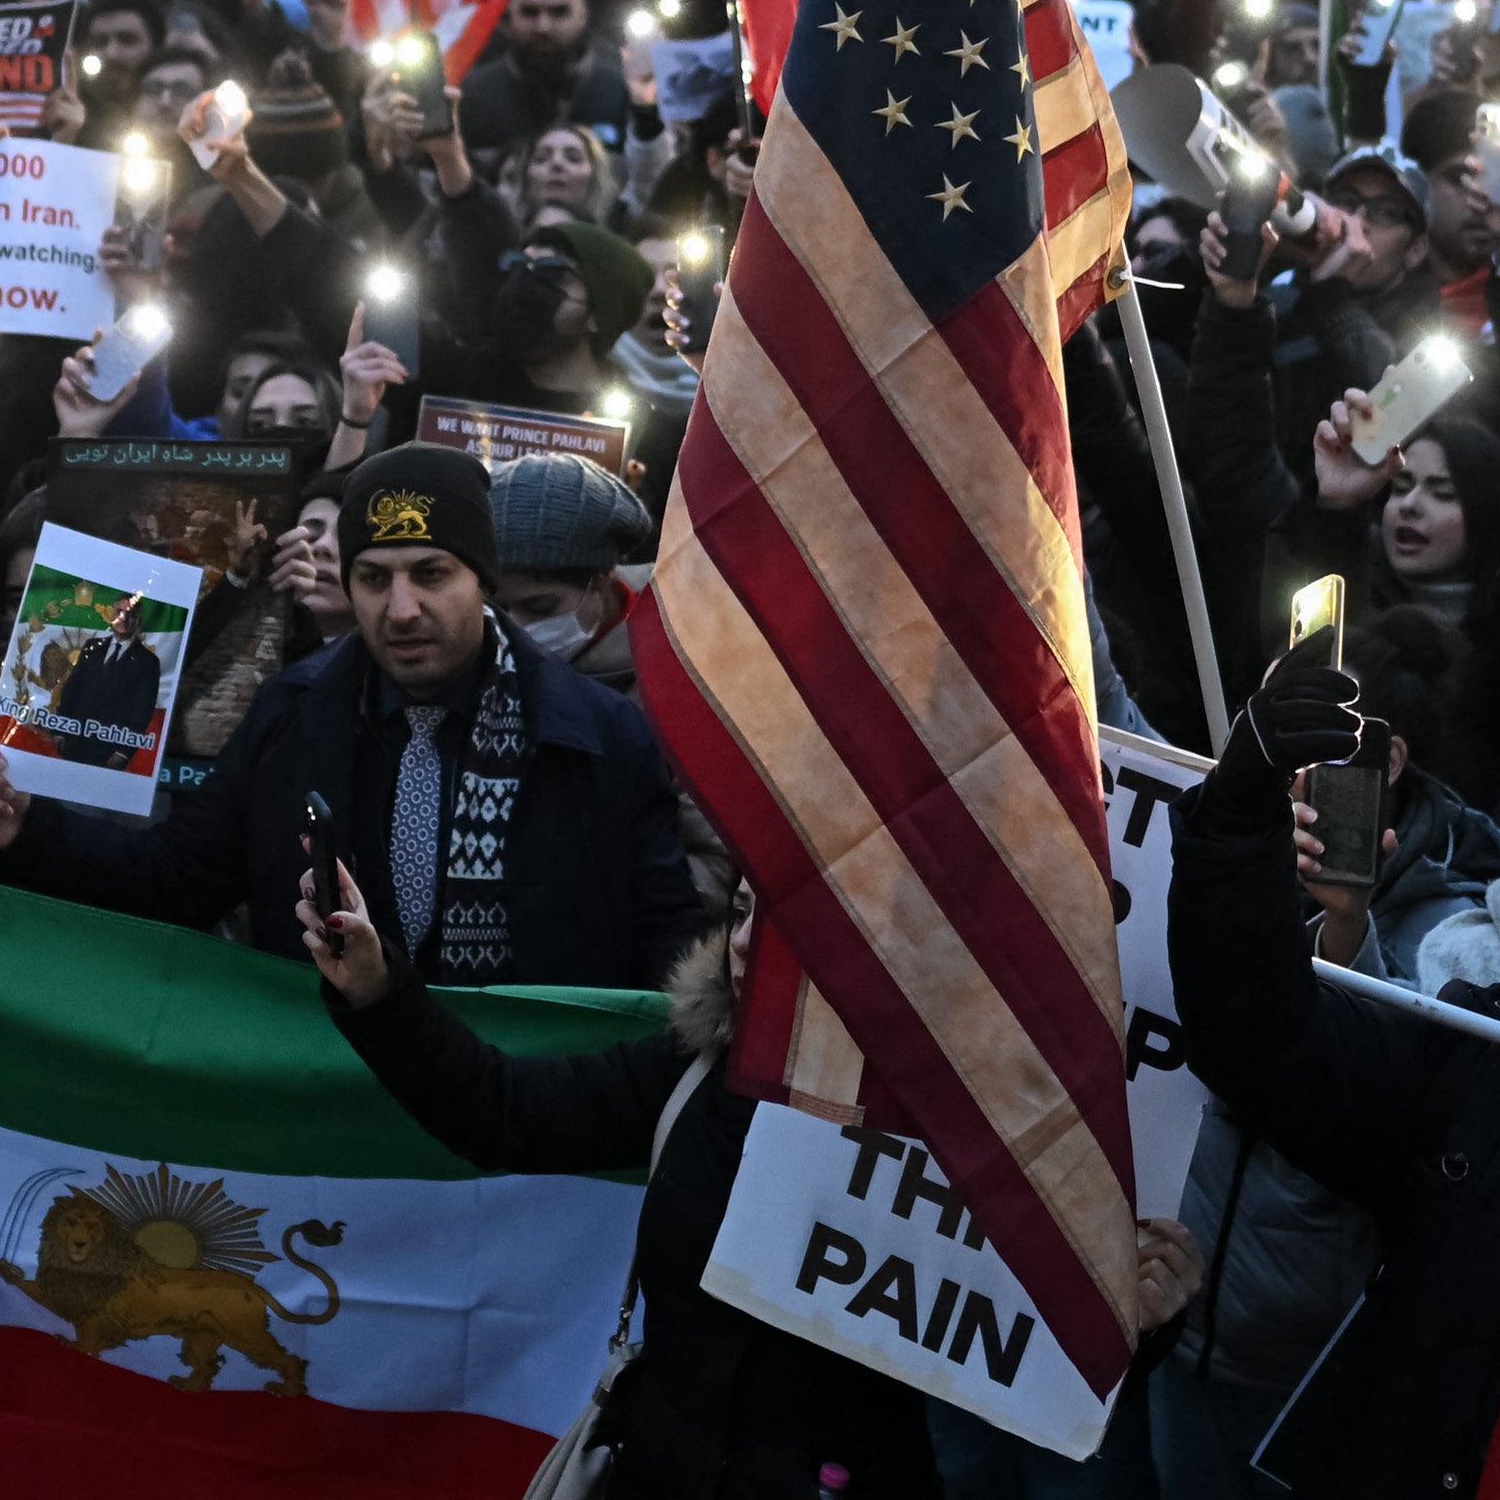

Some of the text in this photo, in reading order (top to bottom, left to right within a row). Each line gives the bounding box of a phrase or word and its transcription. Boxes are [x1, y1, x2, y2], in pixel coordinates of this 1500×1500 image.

[1081, 16, 1118, 32] NT
[21, 199, 82, 229] Iran.
[437, 416, 607, 453] WE WANT PRINCE PAHLAVI
[113, 443, 157, 464] ایران
[201, 451, 232, 467] پدر
[256, 452, 286, 468] پدر
[33, 707, 81, 736] Reza
[83, 718, 157, 751] Pahlavi
[795, 1221, 1036, 1388] PAIN
